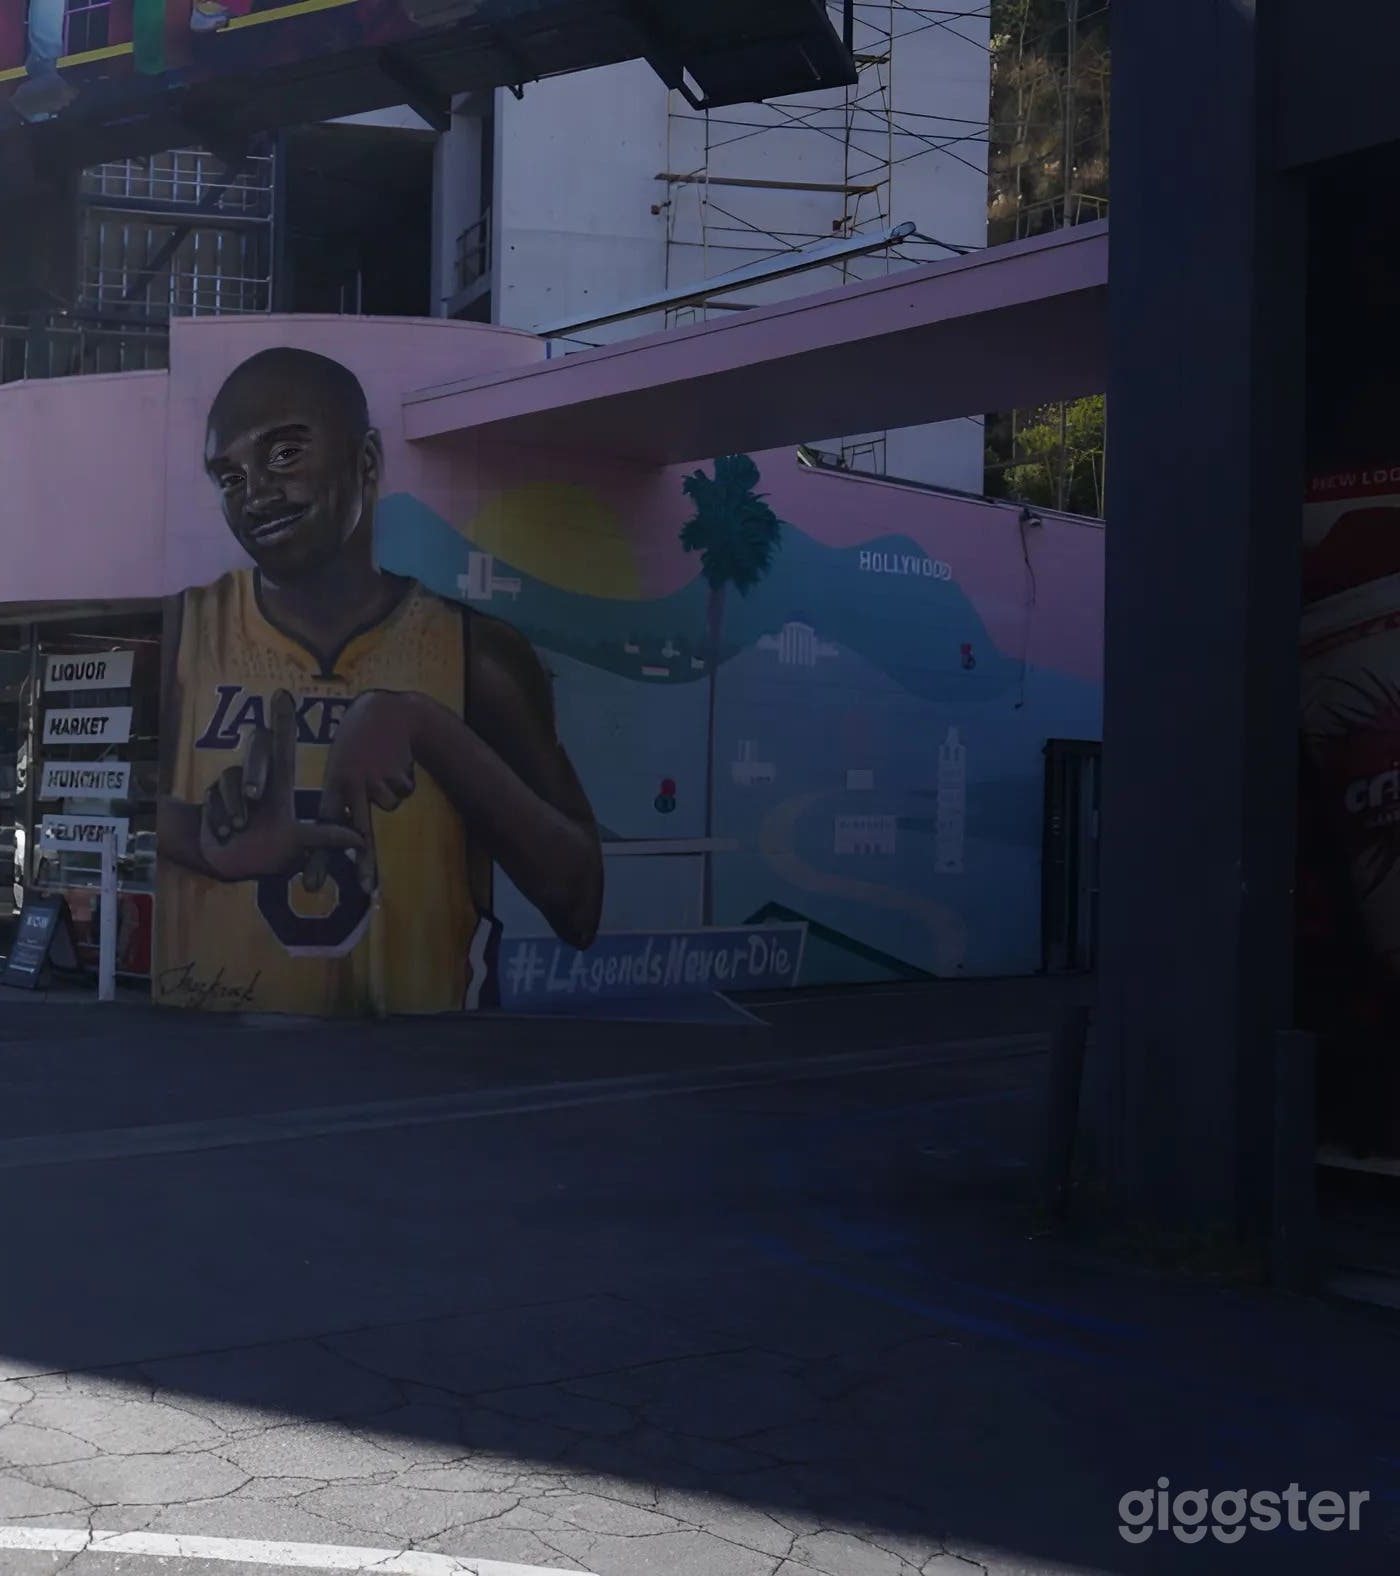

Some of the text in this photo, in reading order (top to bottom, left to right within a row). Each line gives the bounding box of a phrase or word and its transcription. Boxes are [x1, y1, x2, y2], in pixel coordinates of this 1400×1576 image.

[860, 550, 953, 581] HOLLYWOOD
[51, 661, 107, 682] LIQUOR
[49, 716, 110, 736] MARKET
[47, 770, 125, 789] MUNCHIES
